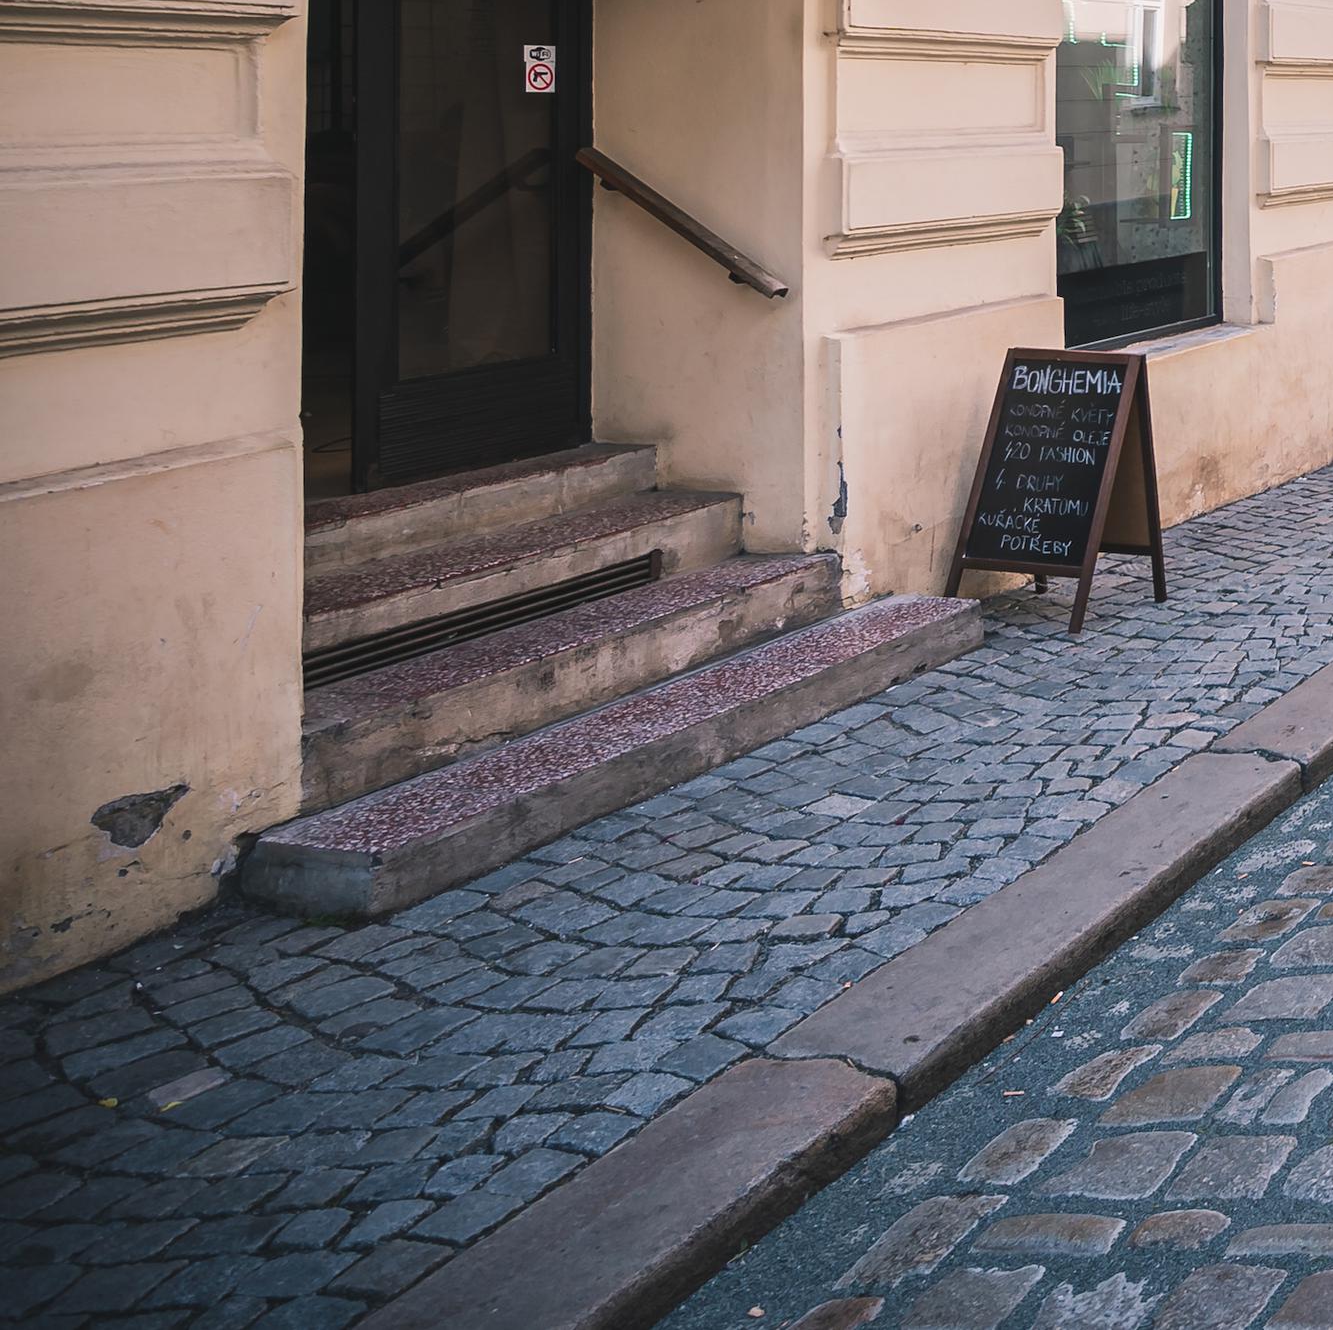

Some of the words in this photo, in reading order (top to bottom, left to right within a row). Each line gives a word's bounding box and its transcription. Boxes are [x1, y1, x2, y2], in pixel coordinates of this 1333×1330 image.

[1012, 364, 1122, 395] BONGHEMIA
[1073, 430, 1111, 446] OLEJE
[1004, 440, 1031, 461] 420
[1039, 446, 1096, 466] FASHION
[1016, 474, 1064, 492] DRUHY
[1023, 497, 1089, 516] KRATOMU
[1000, 533, 1072, 557] POTŘEBY
